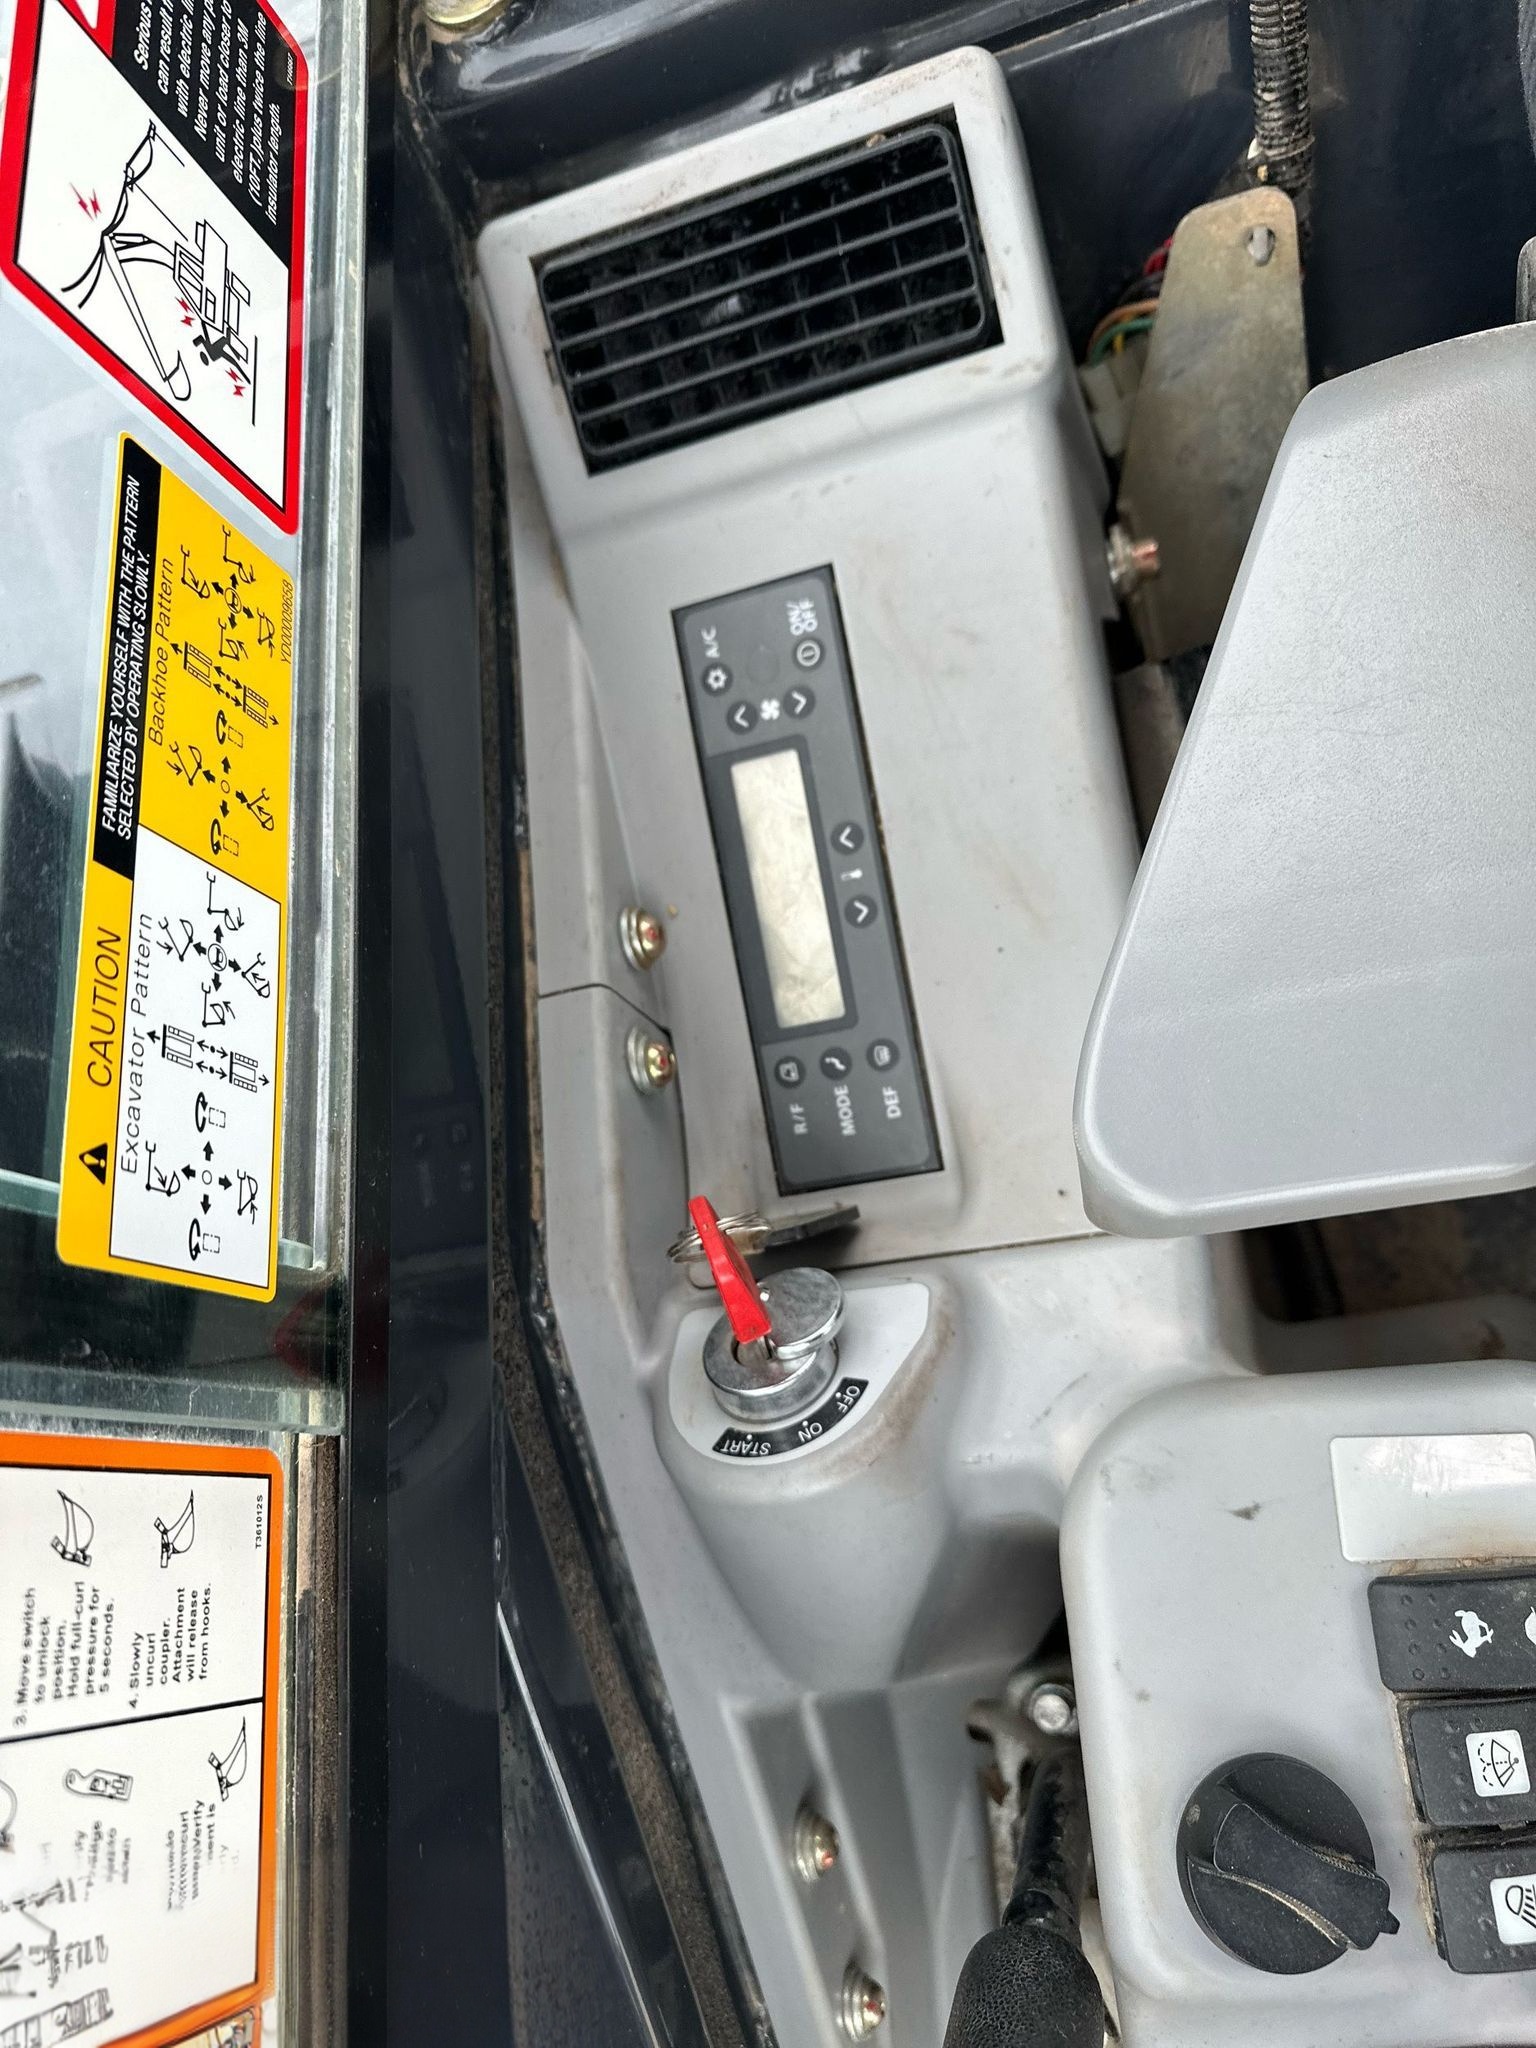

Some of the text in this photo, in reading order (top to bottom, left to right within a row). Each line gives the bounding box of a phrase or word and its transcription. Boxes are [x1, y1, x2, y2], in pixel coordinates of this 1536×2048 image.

[134, 2, 152, 70] Serious
[160, 7, 172, 62] result
[178, 14, 193, 78] electric
[202, 10, 216, 44] any
[254, 12, 267, 51] line
[158, 60, 169, 94] can
[200, 42, 210, 90] move
[214, 0, 232, 162] unit or load closer to
[252, 49, 266, 76] the
[252, 76, 264, 110] twice
[176, 79, 189, 118] with
[194, 88, 208, 140] Never
[232, 18, 250, 184] electric line than 3M
[265, 103, 282, 225] insulator length.
[701, 626, 720, 658] A/C
[787, 602, 804, 635] ON/
[799, 600, 818, 632] OFF
[102, 475, 140, 832] FAMILIARIZE YOURSELF WITH THE PATTERN
[149, 558, 174, 746] Backhoe Pattern
[118, 550, 150, 840] SELECTED BY OPERATING SLOWLY.
[88, 926, 122, 1087] CAUTION
[121, 914, 152, 1174] Excavator Pattern
[790, 1104, 807, 1134] R/F
[834, 1084, 856, 1136] MODE
[882, 1086, 901, 1119] DEF
[798, 1422, 822, 1442] ON
[836, 1386, 860, 1413] OFF
[720, 1440, 771, 1456] START
[17, 1654, 31, 1704] Move
[24, 1587, 36, 1648] switch
[34, 1616, 50, 1703] to unlock
[54, 1620, 66, 1699] position.
[68, 1581, 84, 1697] Hold full-curl
[86, 1586, 100, 1694] pressure for
[100, 1598, 114, 1692] 5 seconds.
[146, 1633, 156, 1687] uncurl
[160, 1618, 171, 1685] coupler.
[172, 1587, 186, 1683] Attachment
[186, 1590, 198, 1682] will release
[199, 1583, 212, 1680] from hooks.
[129, 1632, 144, 1709] 4. Slowly
